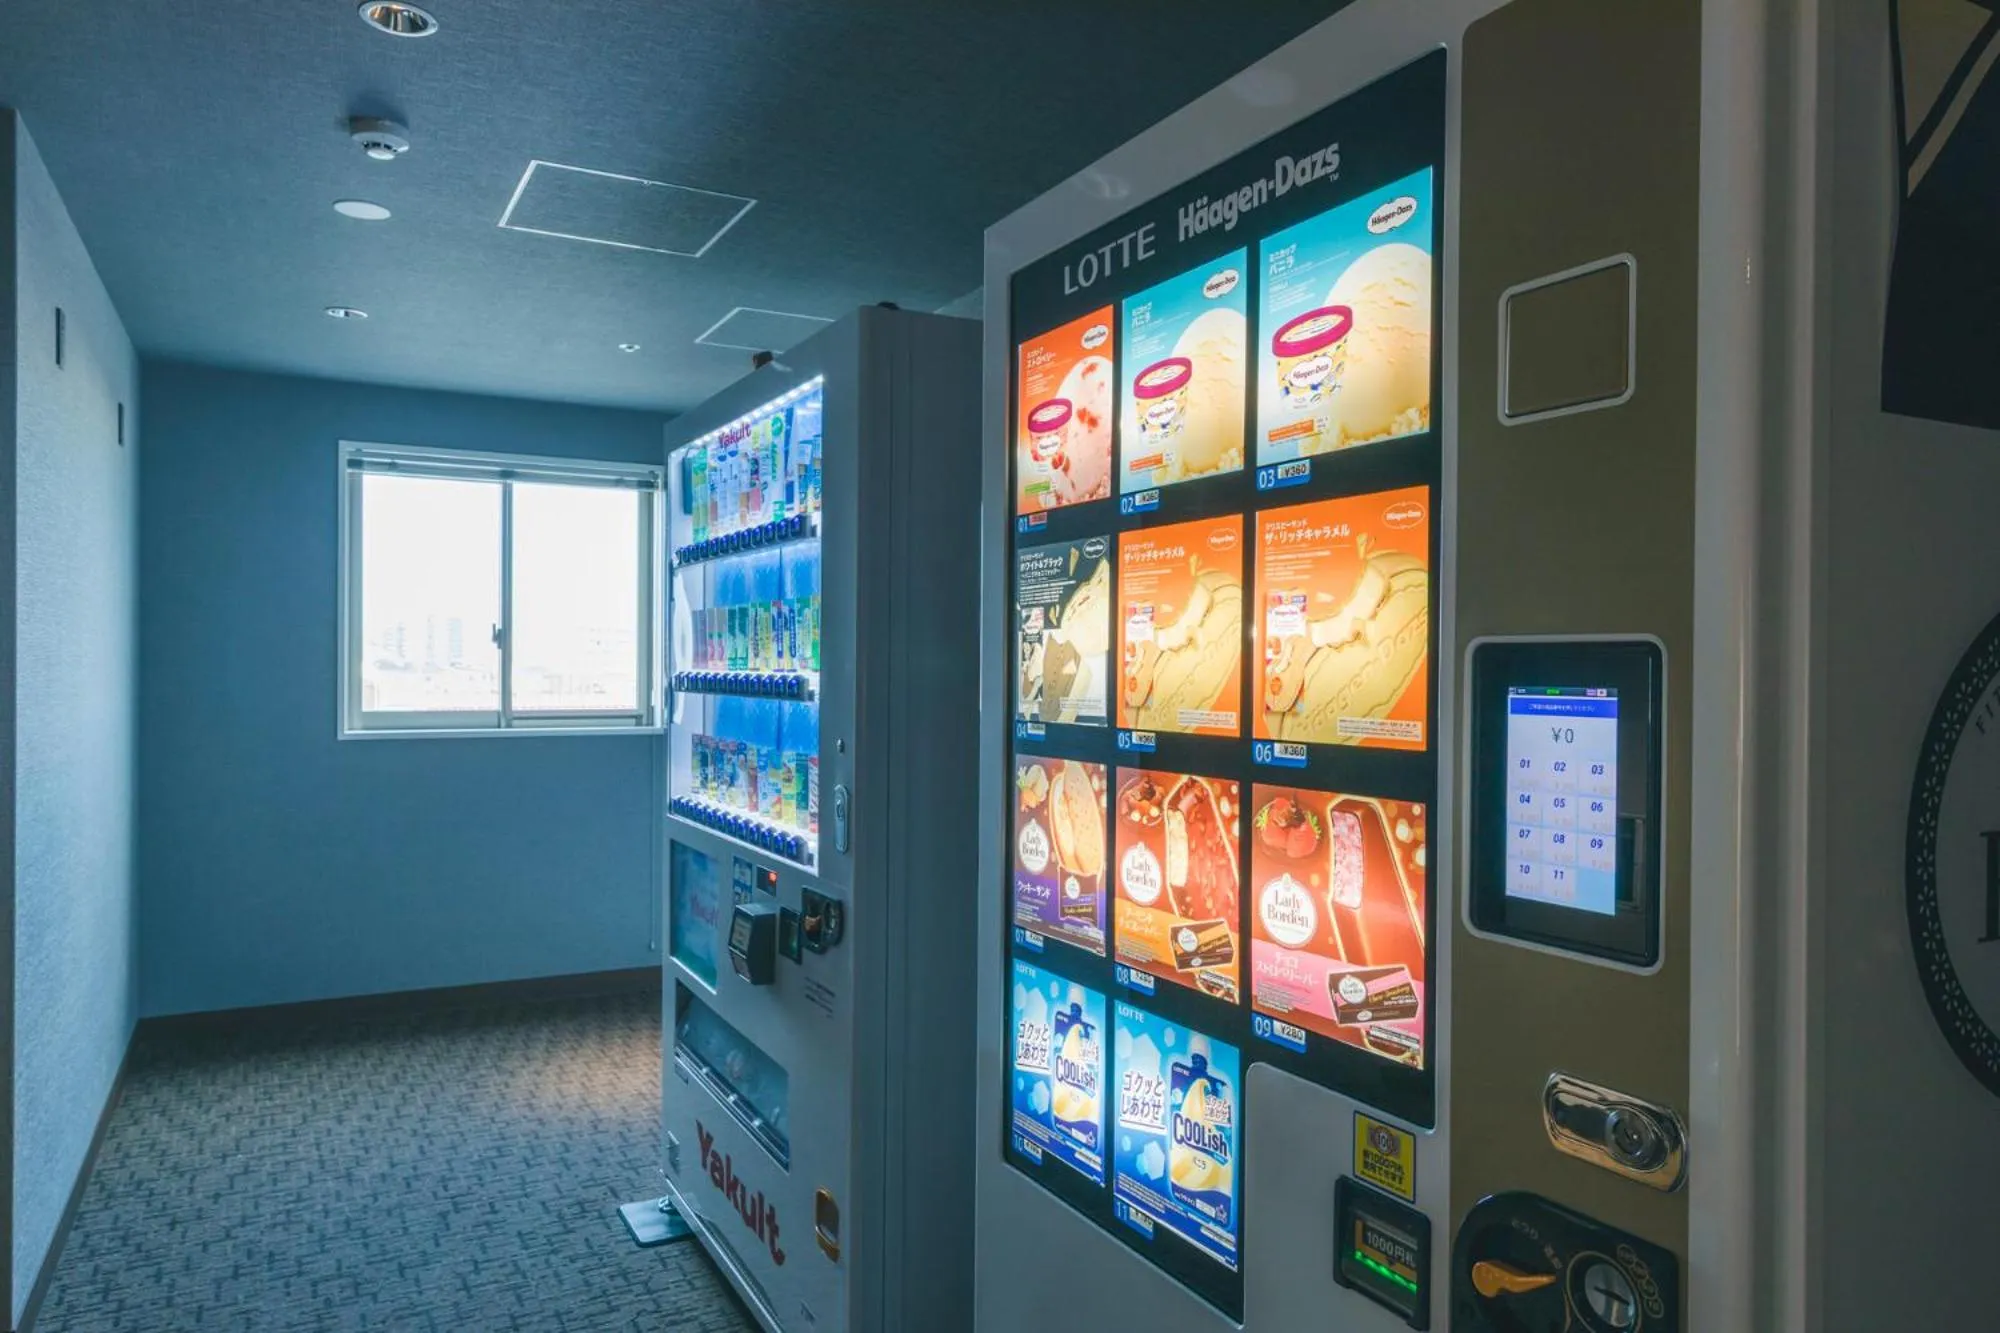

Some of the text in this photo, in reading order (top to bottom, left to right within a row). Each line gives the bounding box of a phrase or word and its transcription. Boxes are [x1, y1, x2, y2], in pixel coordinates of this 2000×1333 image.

[1064, 143, 1341, 295] LOTTE Häagen-Dazs
[1371, 203, 1413, 226] Häagen-Dazs
[718, 421, 752, 449] Yakult
[1259, 468, 1275, 489] 03
[1121, 497, 1134, 513] 02
[1018, 515, 1028, 533] 01
[1118, 733, 1131, 749] 05
[1255, 743, 1272, 762] 06
[1520, 759, 1604, 776] 01 02 03
[1519, 794, 1603, 813] 04 05 06
[1519, 829, 1603, 849] 07 08 09
[1519, 864, 1564, 880] 10 11
[1274, 889, 1301, 911] Lady
[1267, 903, 1309, 929] Borden
[1015, 927, 1025, 943] 07
[1116, 966, 1129, 985] 08
[1118, 1006, 1145, 1023] LOTTE
[1255, 1016, 1271, 1038] 09
[1121, 1093, 1163, 1121] しあわせ
[695, 1118, 787, 1267] Yakult
[1116, 1201, 1128, 1221] 11
